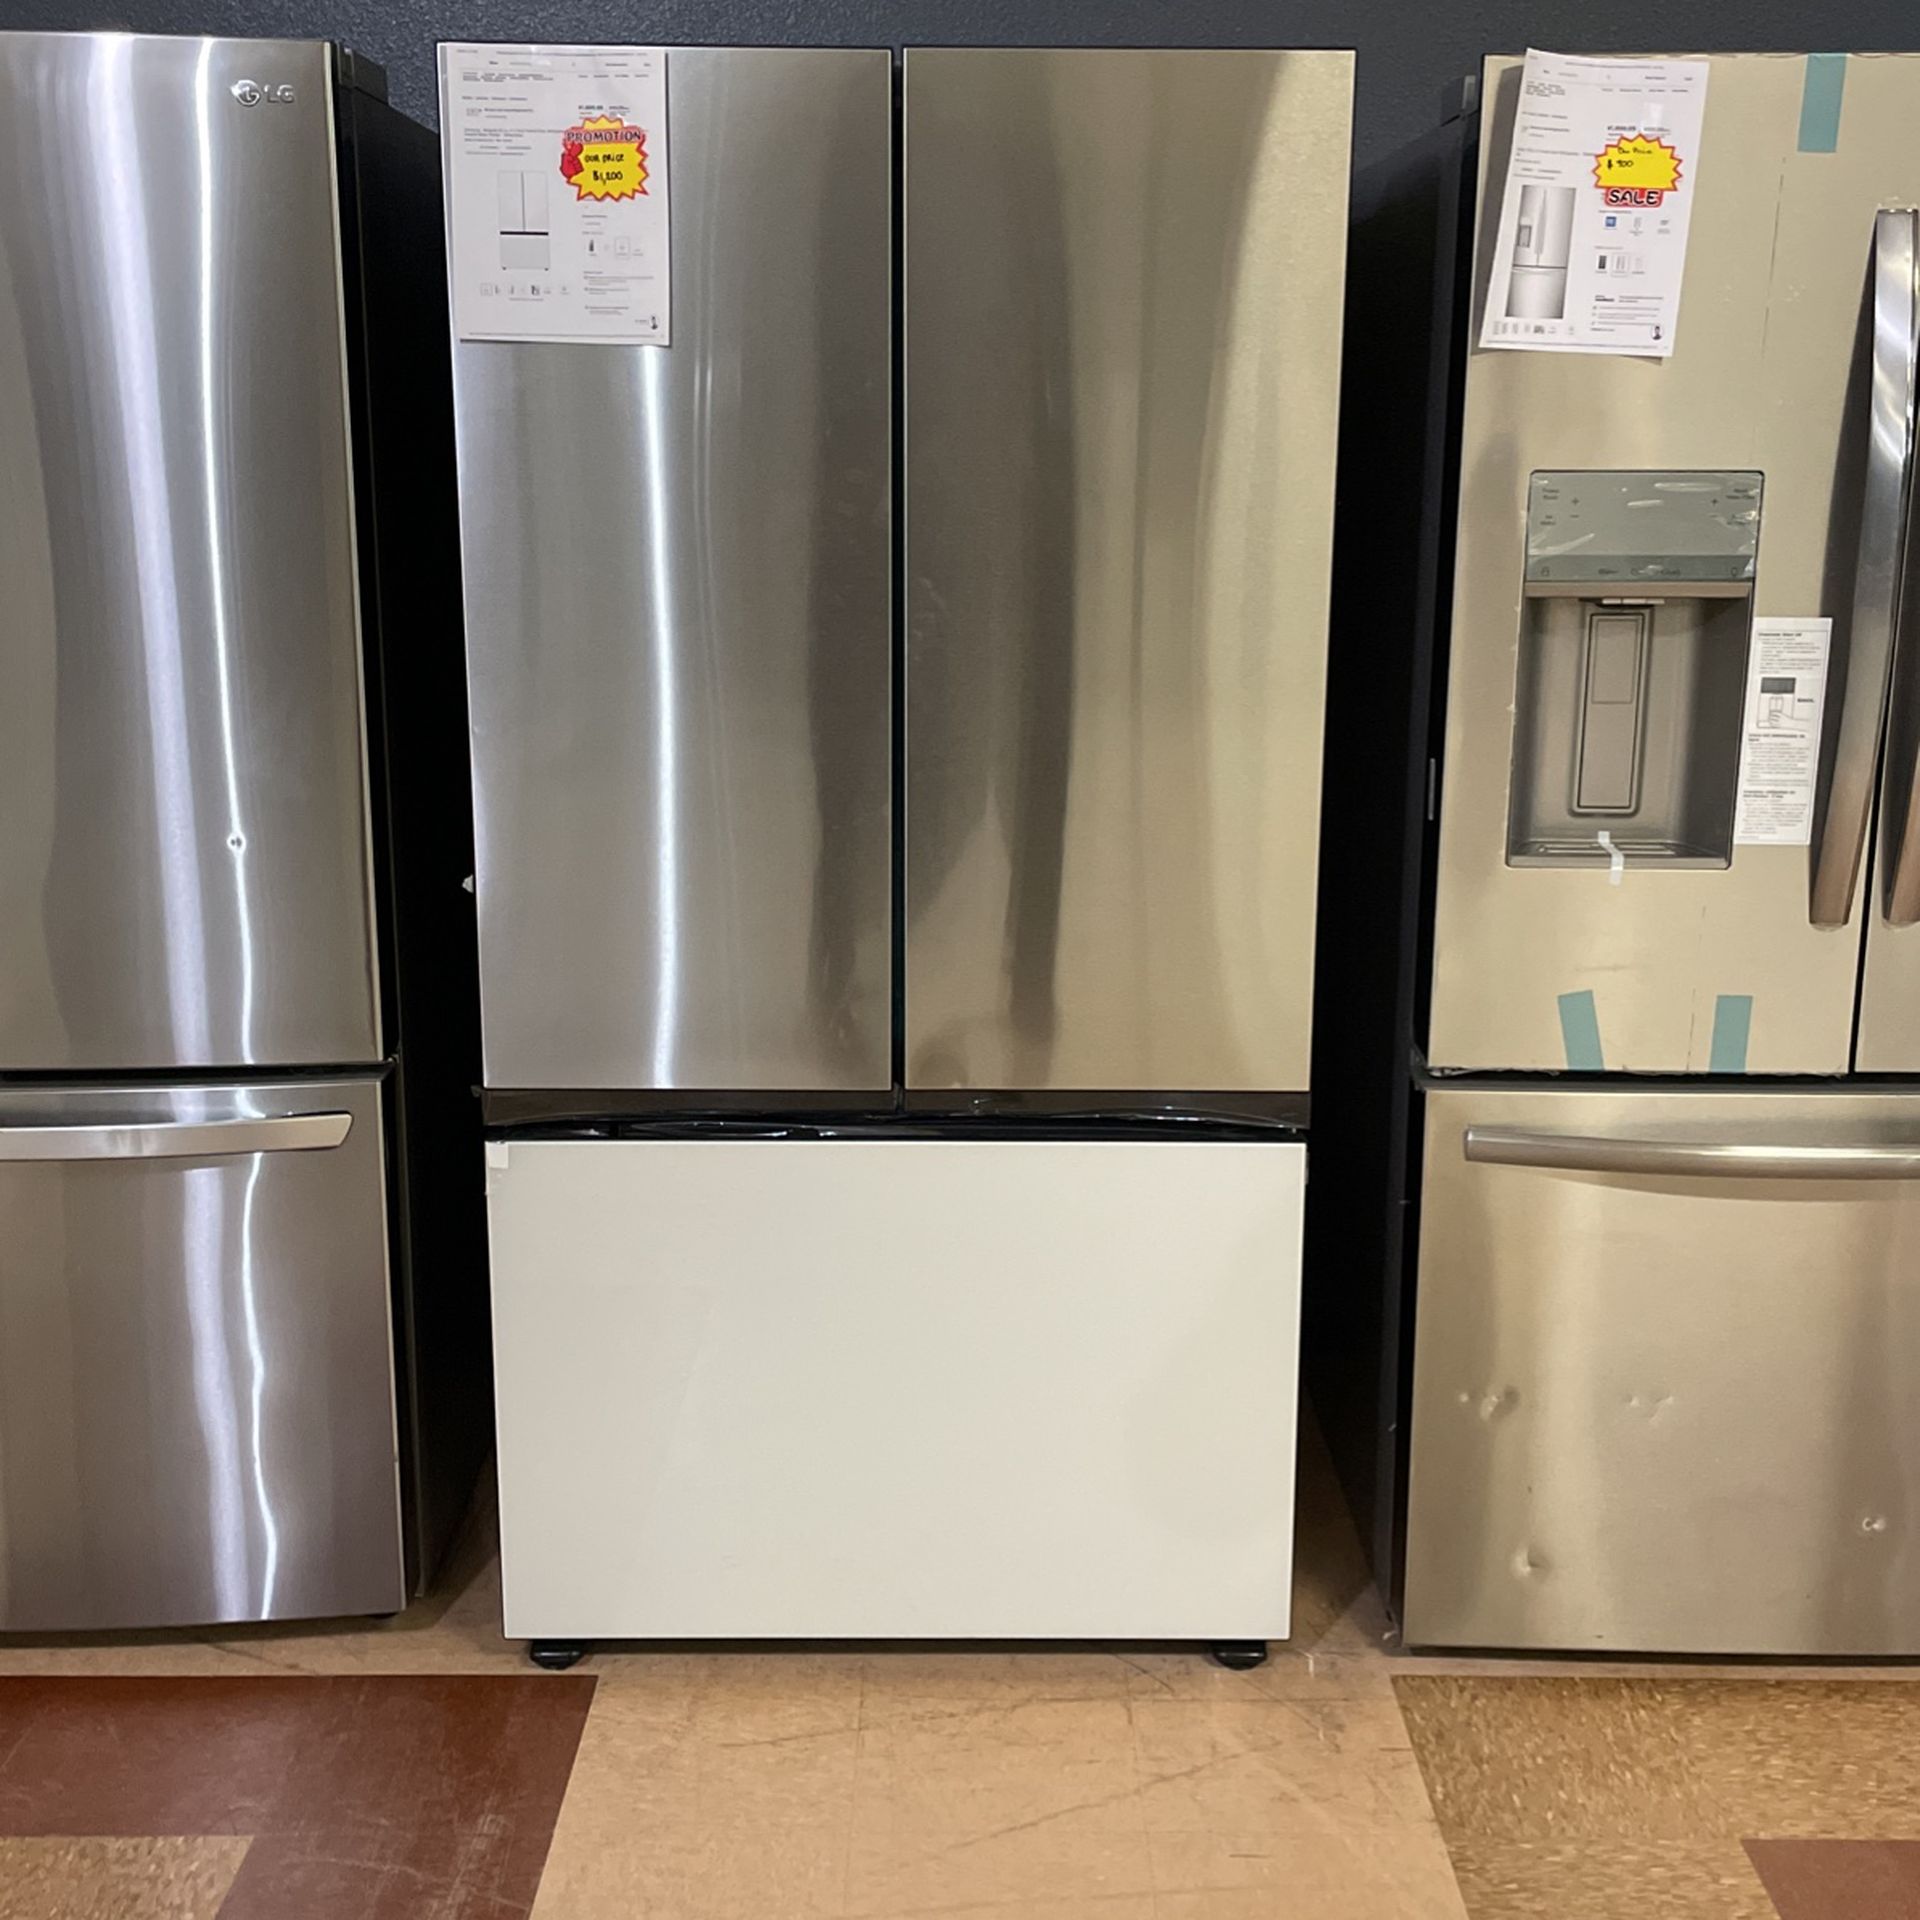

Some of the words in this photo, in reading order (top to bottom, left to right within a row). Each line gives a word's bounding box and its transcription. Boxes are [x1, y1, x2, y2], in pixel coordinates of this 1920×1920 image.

[264, 84, 295, 104] LG
[567, 130, 641, 142] PROMOTION
[1608, 189, 1660, 205] SALE
